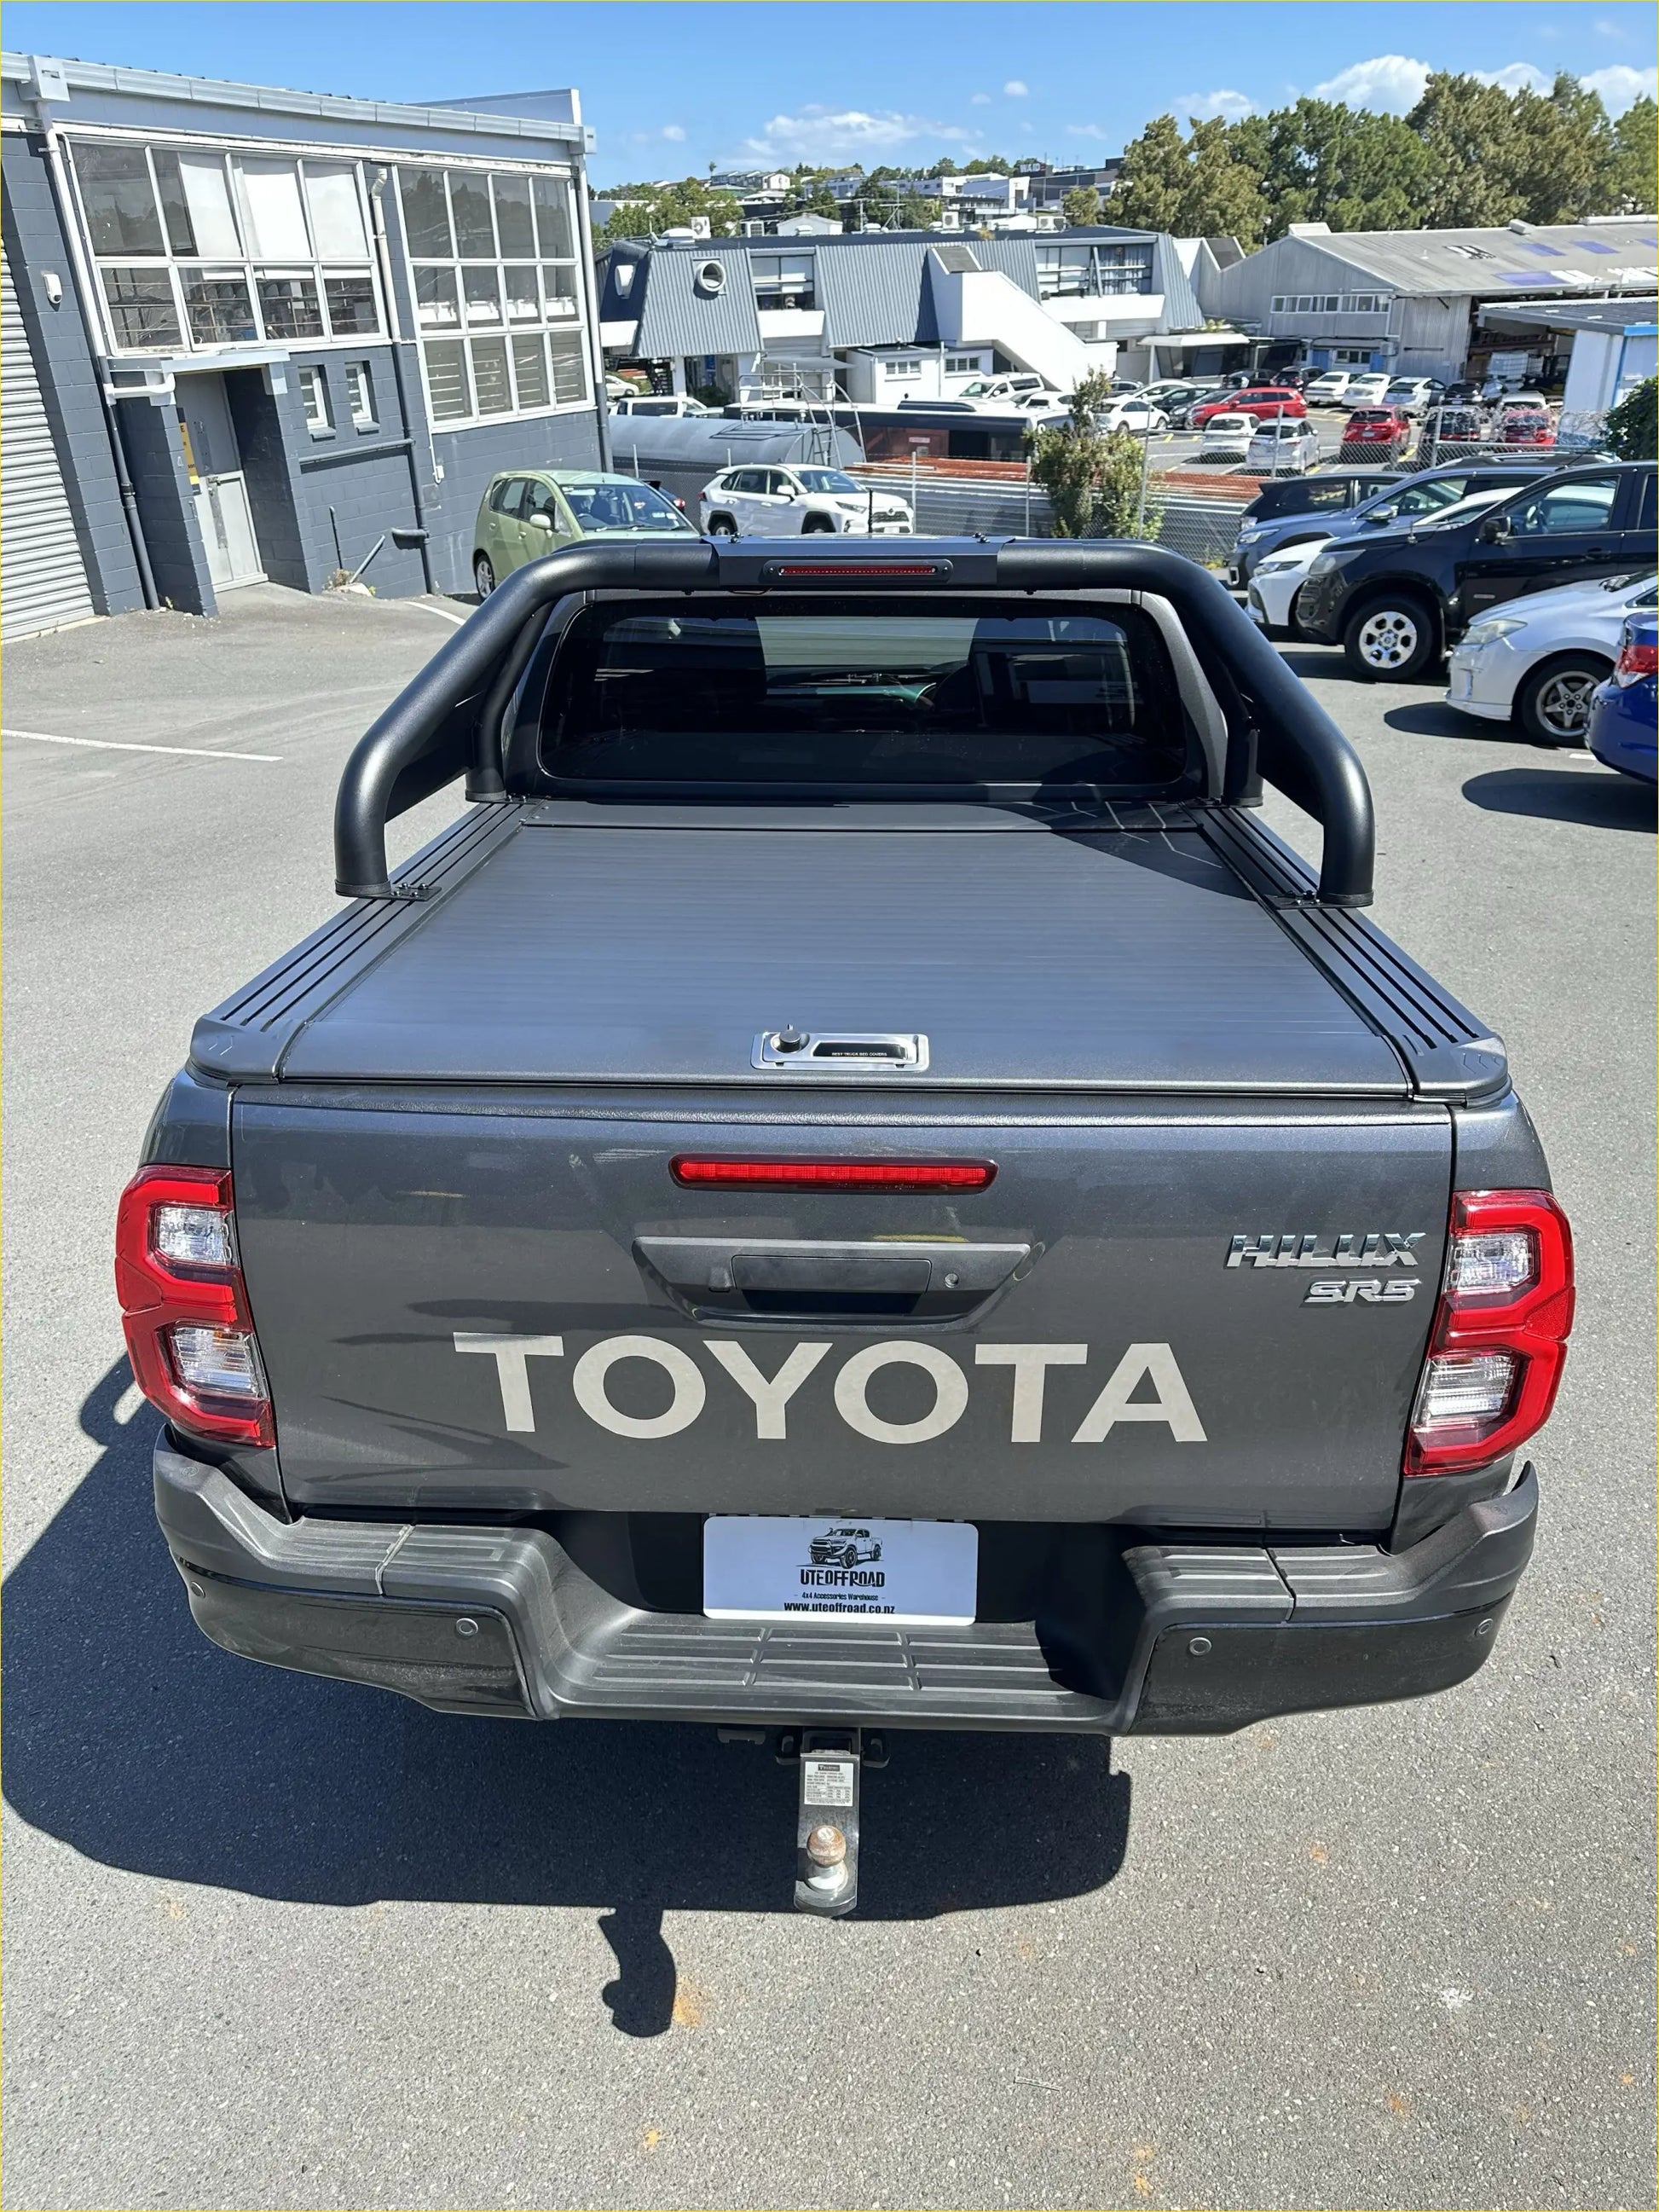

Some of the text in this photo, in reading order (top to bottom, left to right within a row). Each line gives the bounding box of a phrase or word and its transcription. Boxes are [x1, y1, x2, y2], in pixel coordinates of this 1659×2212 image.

[1225, 1232, 1426, 1268] HILUX
[1304, 1278, 1422, 1304] SR5
[453, 1331, 1208, 1445] TOYOTA
[801, 1569, 885, 1587] UTEOFFROAD
[801, 1591, 879, 1601] 4x4 Accessories Warehouse
[784, 1602, 895, 1614] www.uteoffroad.co.nz
